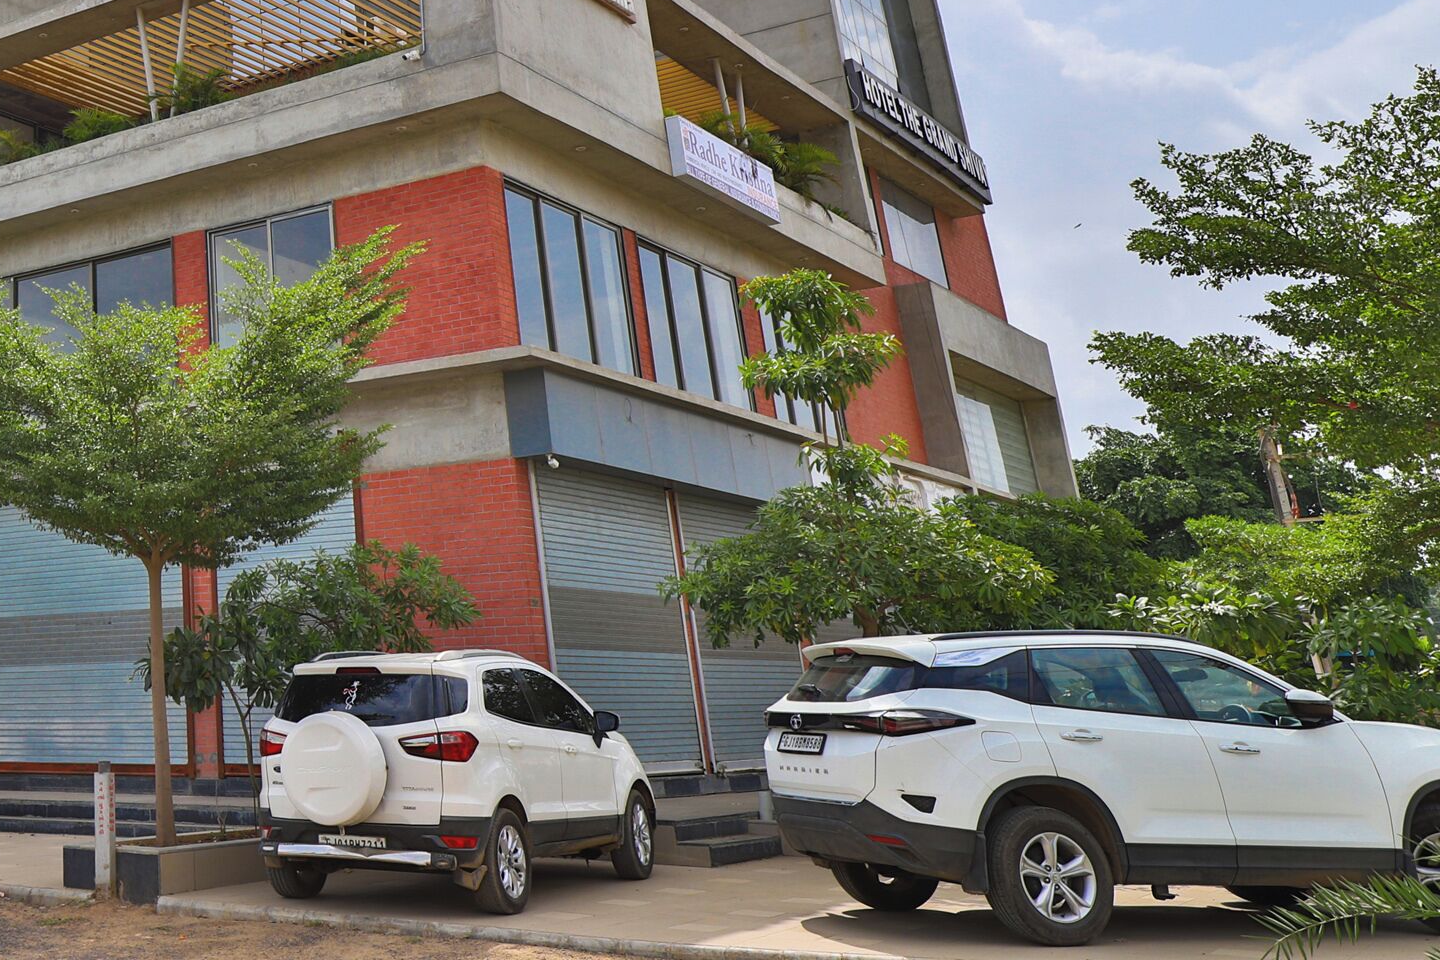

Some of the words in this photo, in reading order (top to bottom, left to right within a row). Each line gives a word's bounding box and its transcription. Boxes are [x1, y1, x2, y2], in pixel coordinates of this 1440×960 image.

[688, 131, 728, 173] Radhe
[860, 70, 903, 123] HOTEL
[898, 97, 924, 138] THE
[922, 115, 959, 163] GRAND
[956, 142, 987, 188] SHIVA
